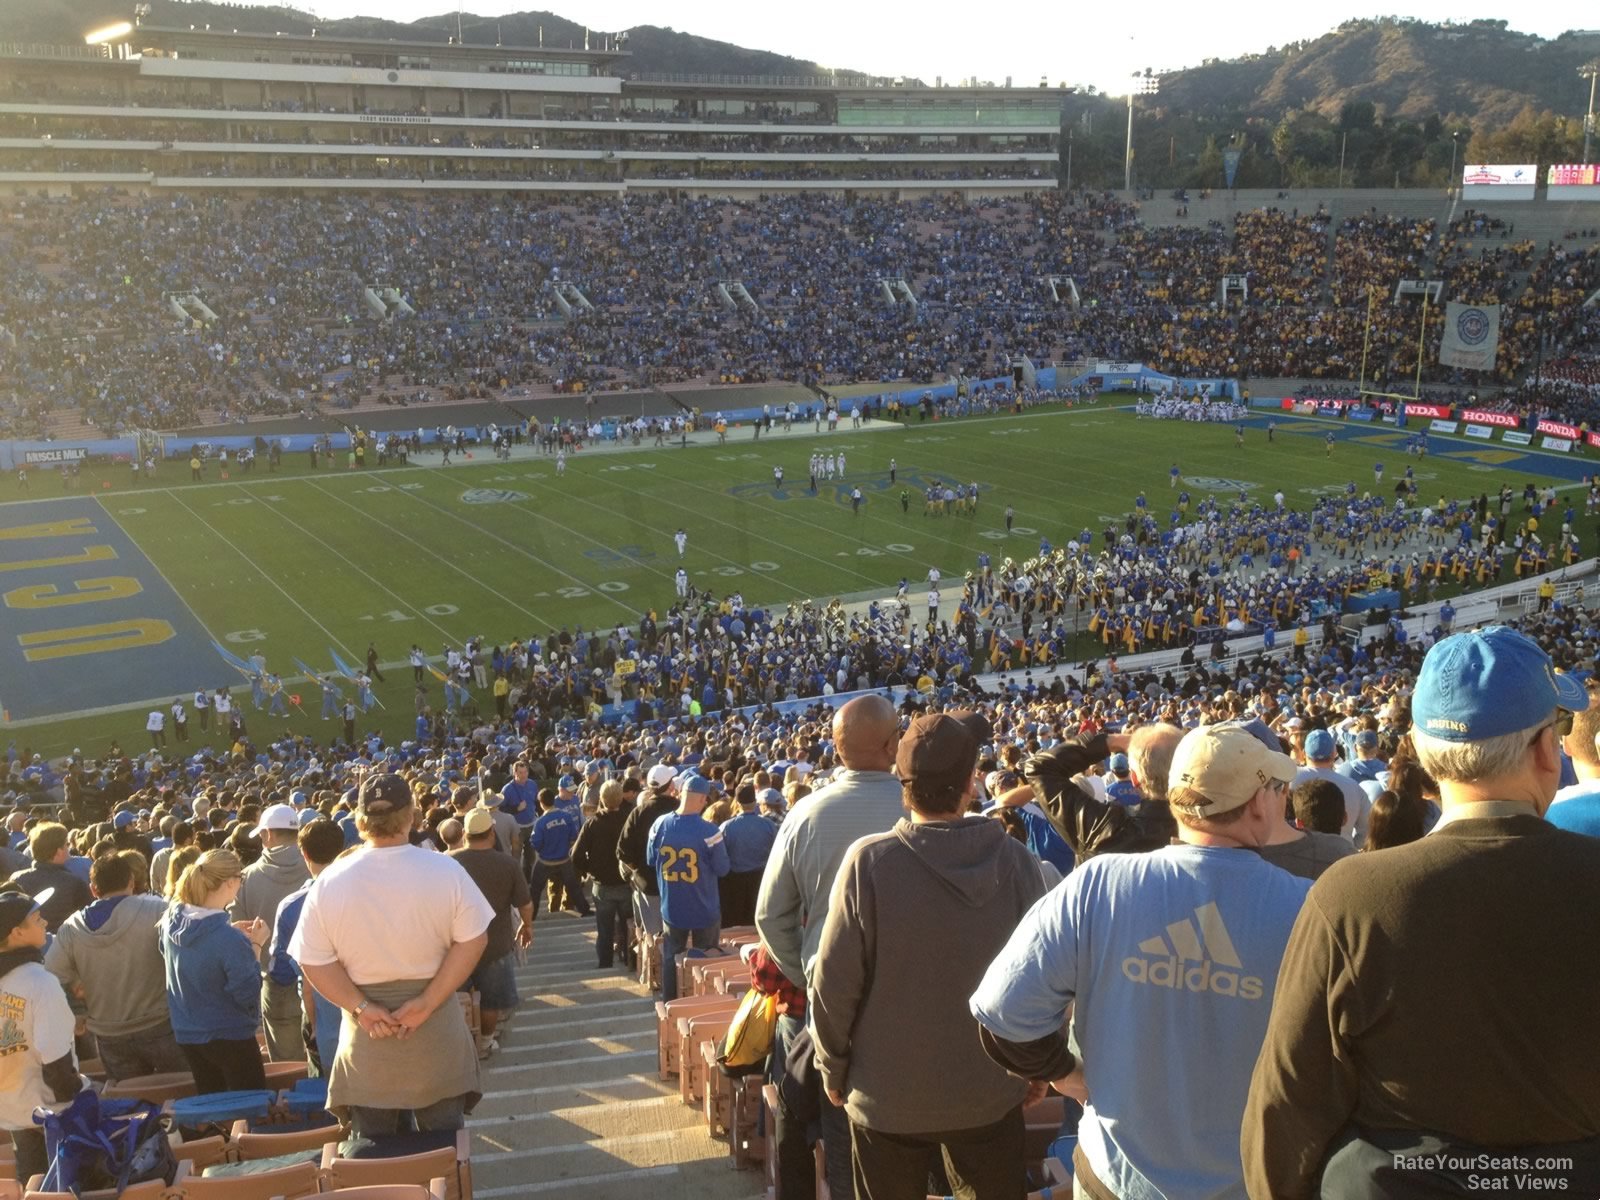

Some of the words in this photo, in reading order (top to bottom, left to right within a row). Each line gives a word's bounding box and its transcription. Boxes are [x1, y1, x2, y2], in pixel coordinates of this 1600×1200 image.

[1463, 410, 1517, 426] HONDA
[1537, 420, 1577, 438] HONDA
[26, 451, 61, 463] MUSCLE
[63, 448, 86, 460] MILK
[0, 517, 177, 662] UCLA
[556, 581, 630, 598] 20
[382, 604, 460, 622] 10
[1426, 719, 1468, 733] BRUINS
[660, 846, 698, 884] 23
[1122, 955, 1264, 1000] adidas
